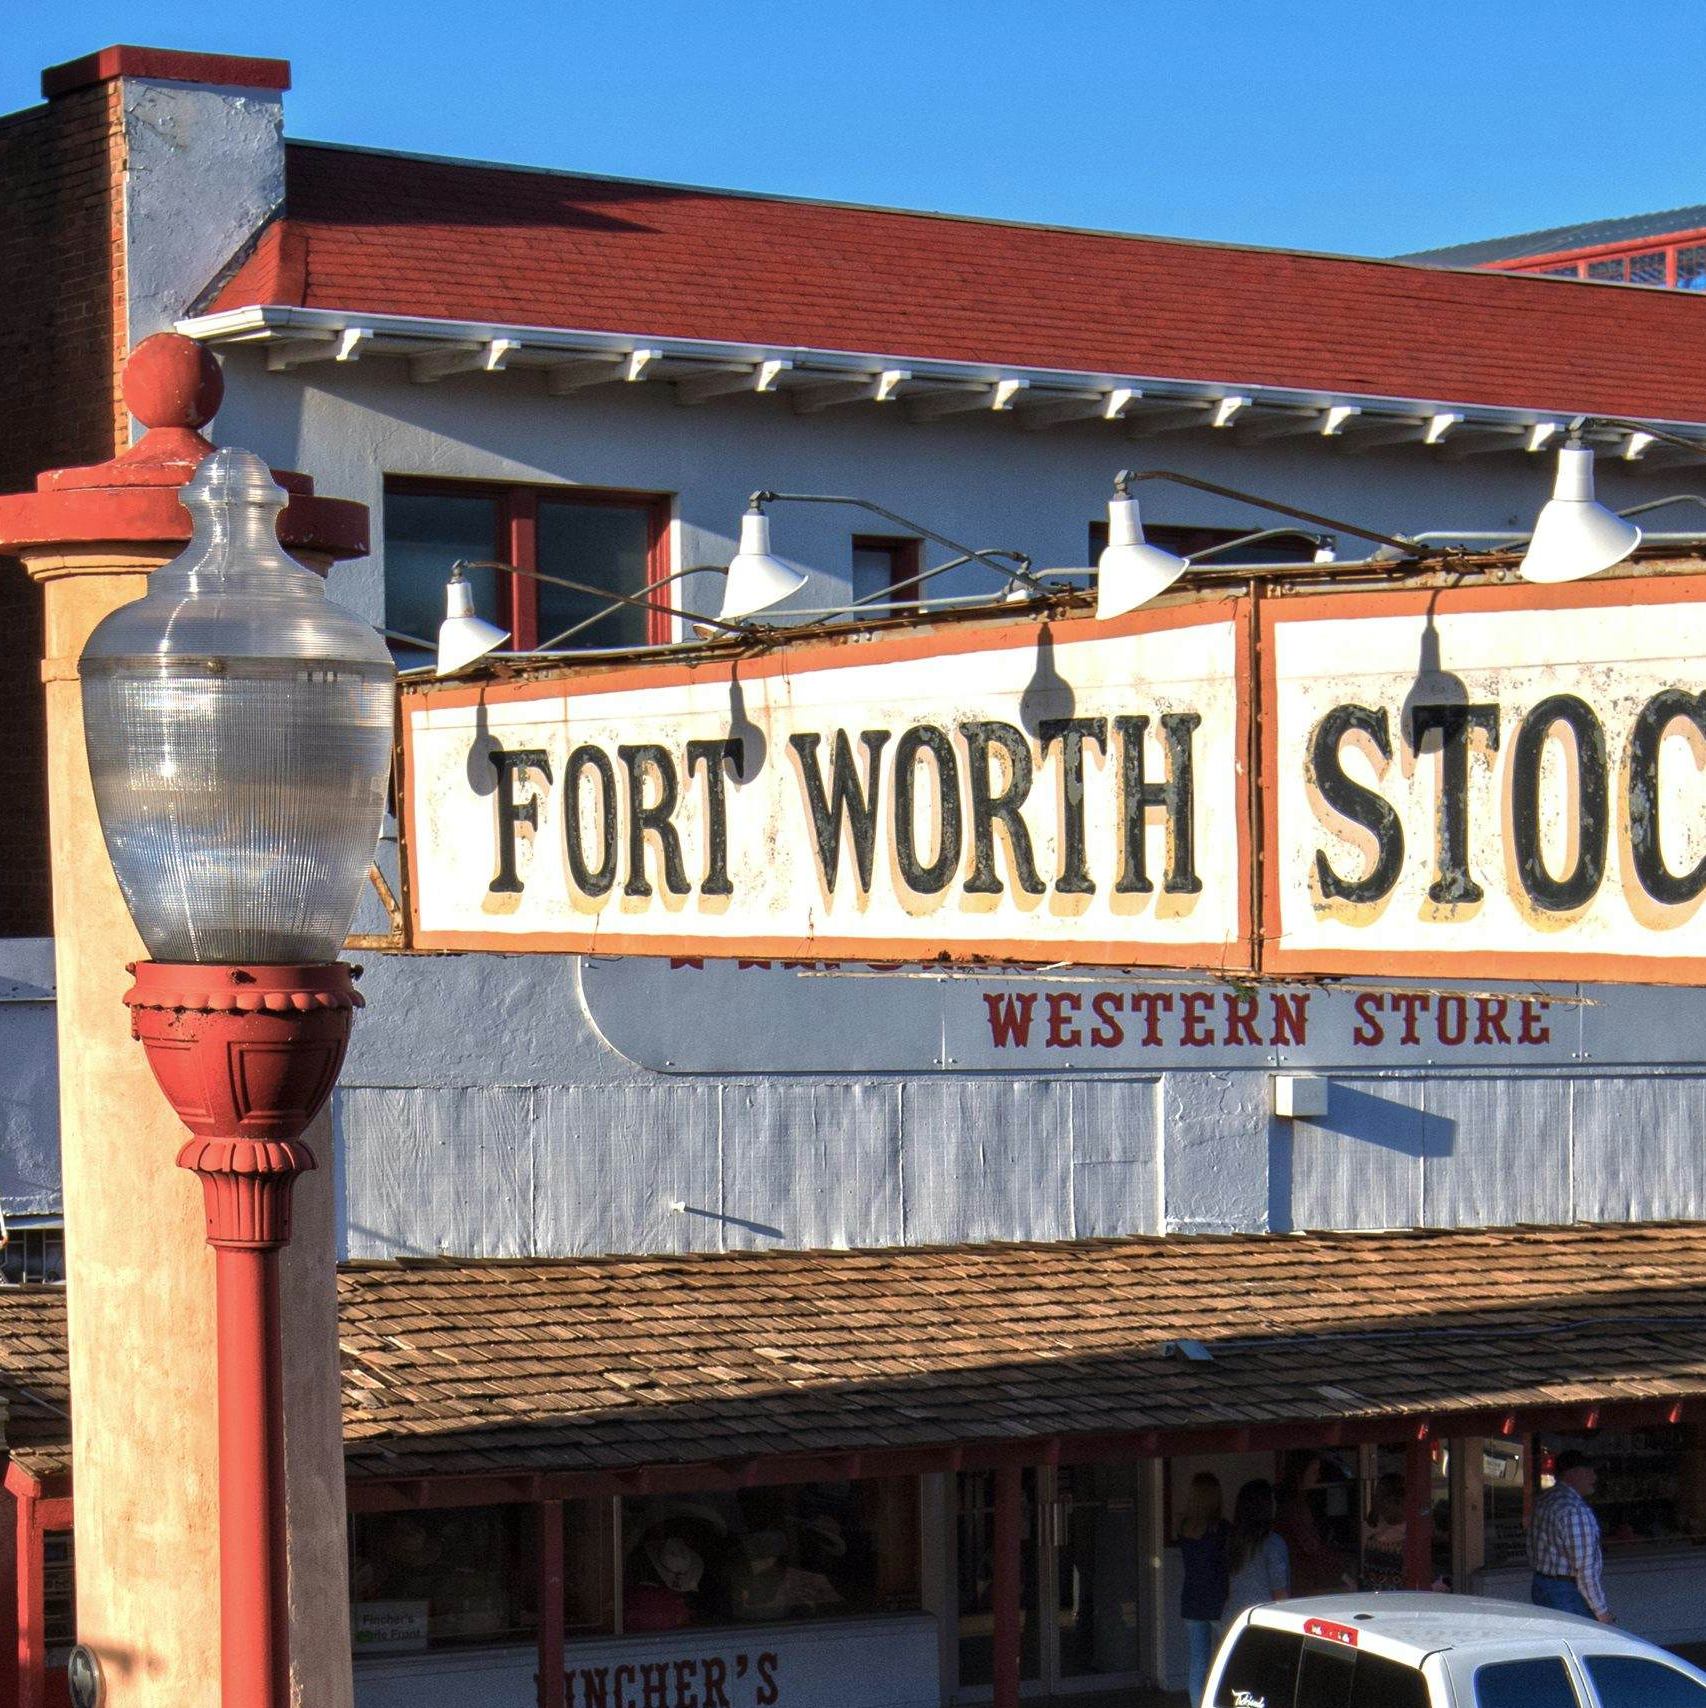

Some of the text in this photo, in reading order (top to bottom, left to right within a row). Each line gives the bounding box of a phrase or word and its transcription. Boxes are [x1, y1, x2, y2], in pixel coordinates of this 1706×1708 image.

[488, 738, 744, 898] FORT
[791, 712, 1202, 895] WORTH
[983, 993, 1550, 1048] WESTERN STORE
